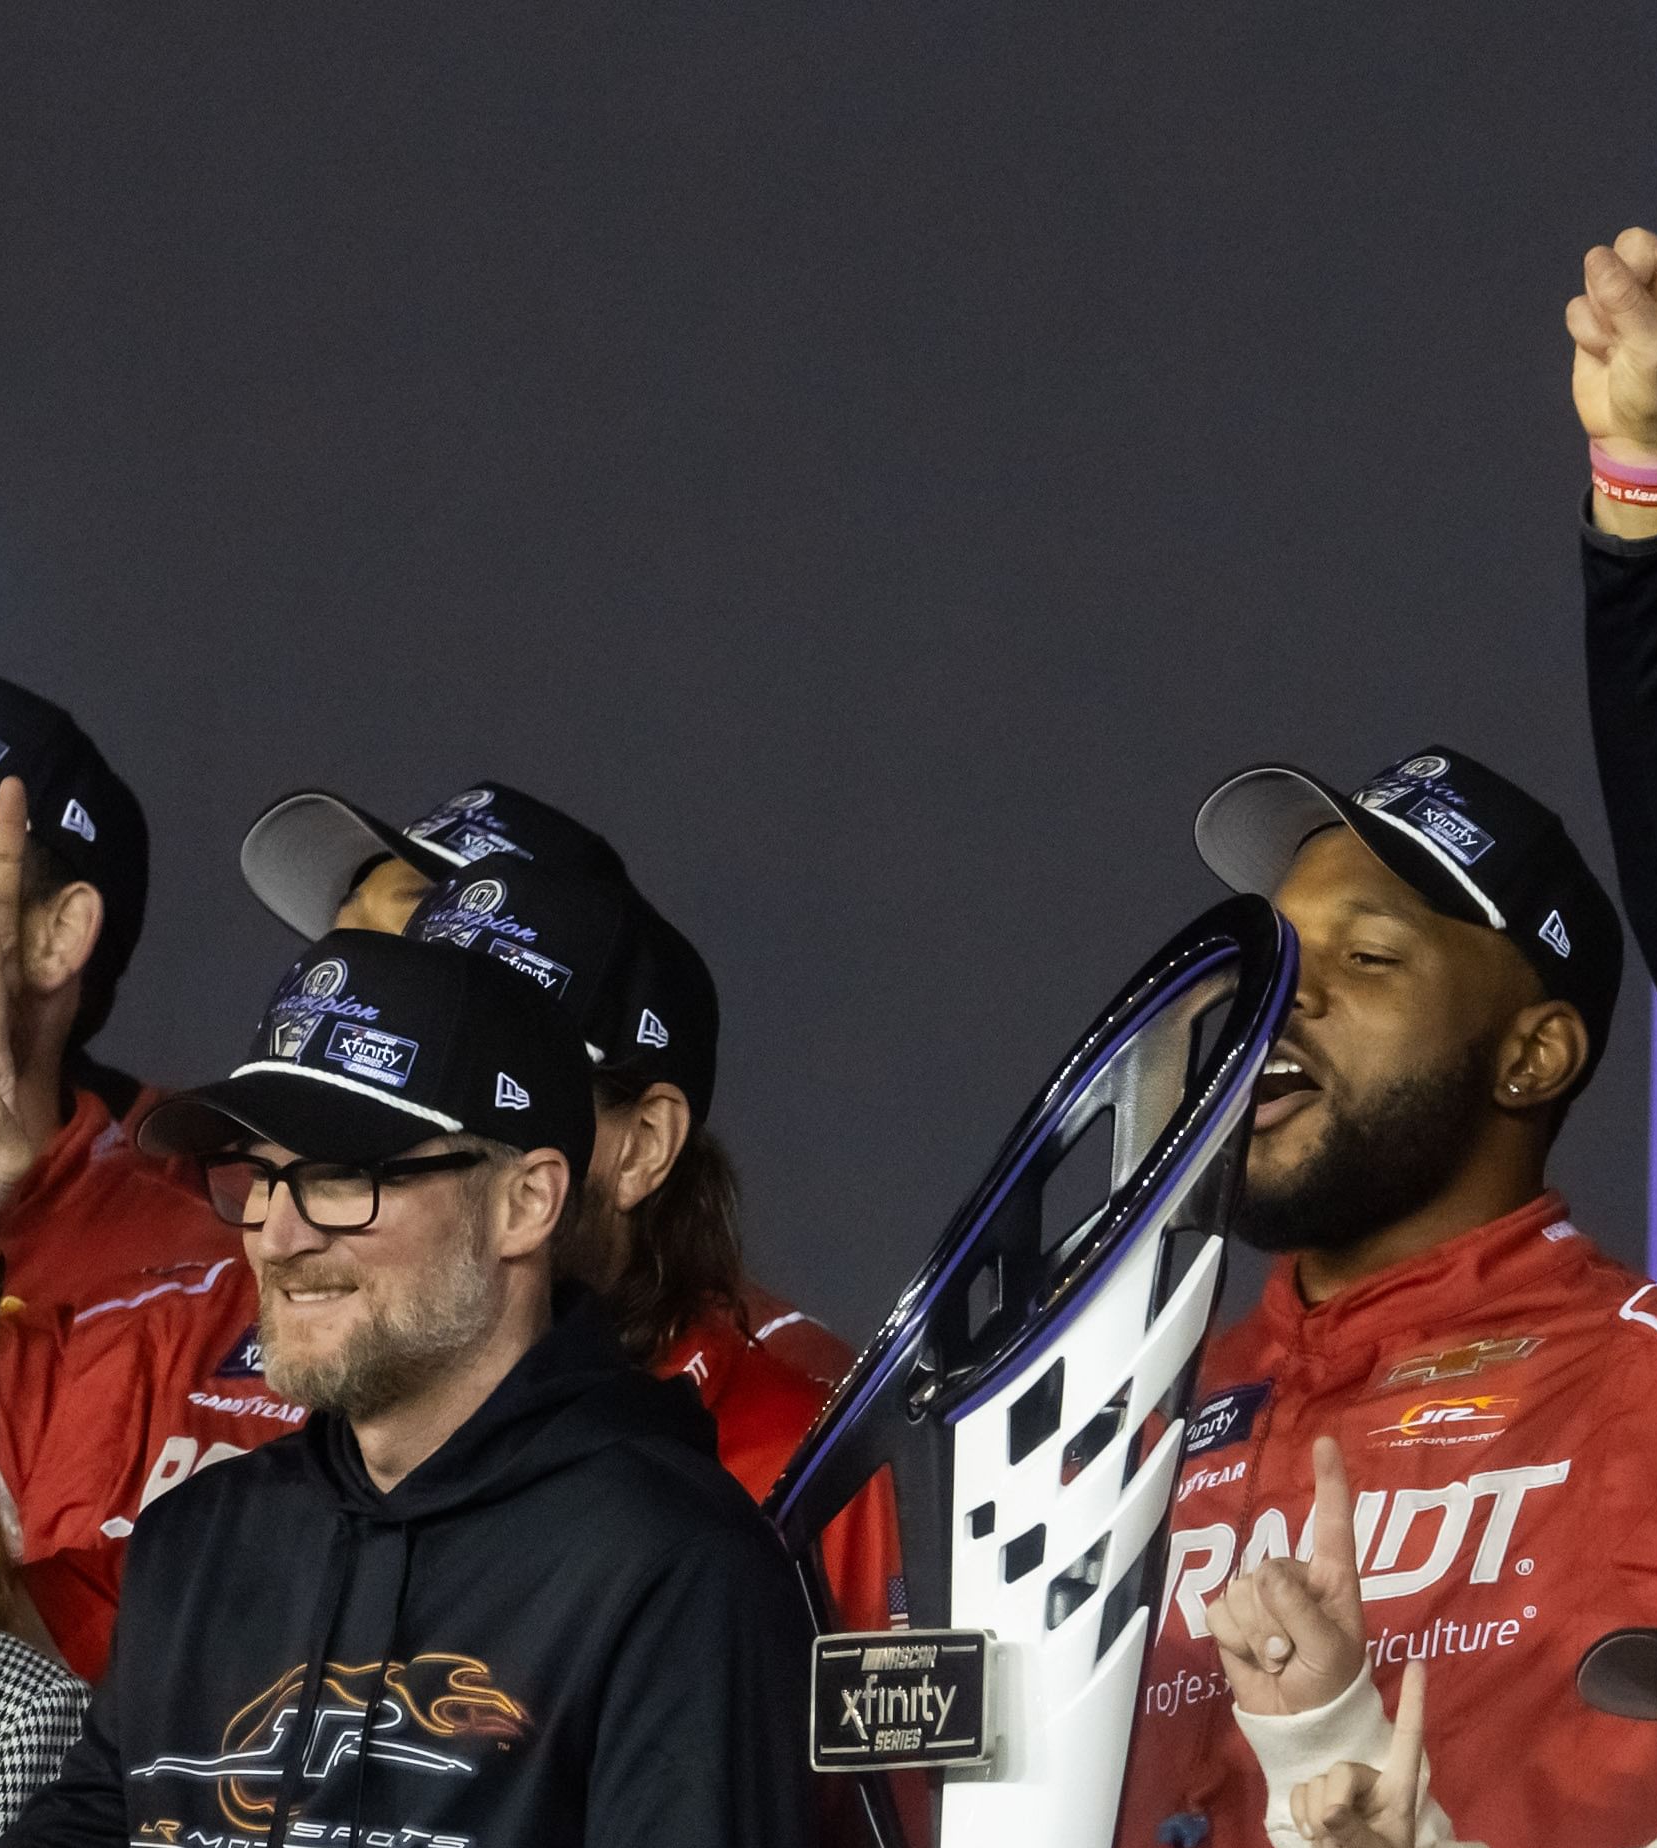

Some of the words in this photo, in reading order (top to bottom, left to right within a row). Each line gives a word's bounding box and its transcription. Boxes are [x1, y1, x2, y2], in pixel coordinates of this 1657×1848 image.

[1423, 807, 1478, 846] xfinity
[340, 1037, 403, 1067] xfinity
[188, 1392, 306, 1424] GOODYEAR
[880, 1645, 938, 1670] NASCAR
[840, 1674, 956, 1740] xfinity
[874, 1728, 922, 1751] SERIES
